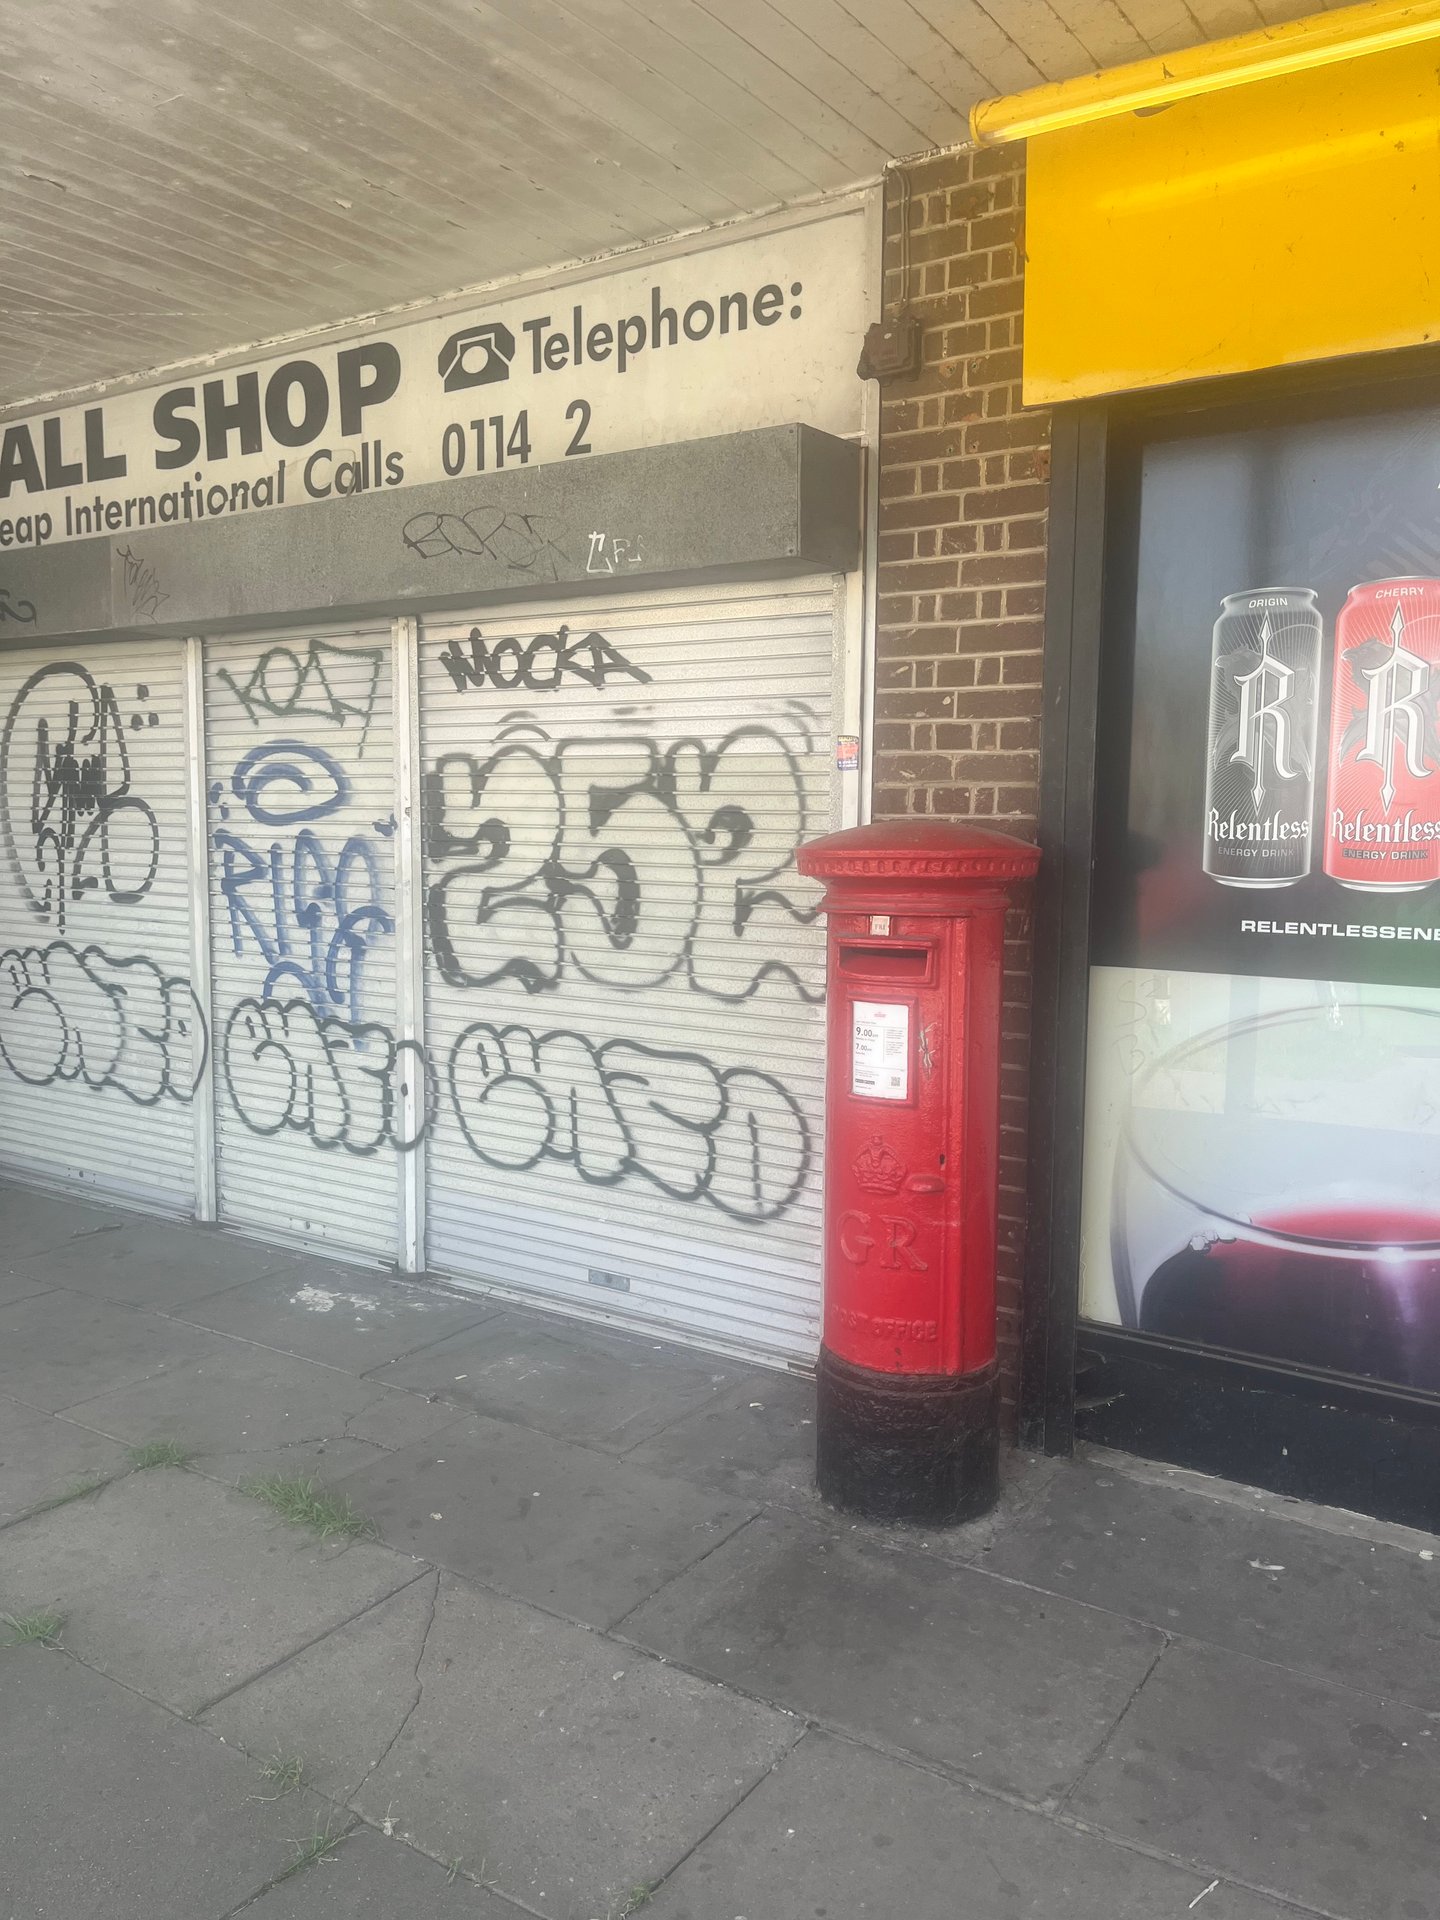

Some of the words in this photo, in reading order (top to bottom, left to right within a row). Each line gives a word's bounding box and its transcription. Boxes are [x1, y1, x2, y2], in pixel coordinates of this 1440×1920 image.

[522, 281, 802, 375] Telephone:
[0, 407, 127, 499] ALL
[153, 342, 401, 470] SHOP
[442, 409, 532, 476] 0114
[564, 399, 592, 456] 2
[0, 512, 52, 546] eap
[65, 459, 286, 536] International
[303, 439, 404, 499] Calls
[1248, 597, 1288, 609] ORIGIN
[1375, 587, 1425, 599] CHERRY
[1207, 807, 1310, 842] Relentless
[1331, 807, 1440, 843] Relentless
[1217, 846, 1258, 858] ENERGY
[1261, 848, 1295, 858] DRINK
[1342, 848, 1387, 860] ENERGY
[1390, 849, 1427, 860] DRINK
[837, 1209, 929, 1271] GR
